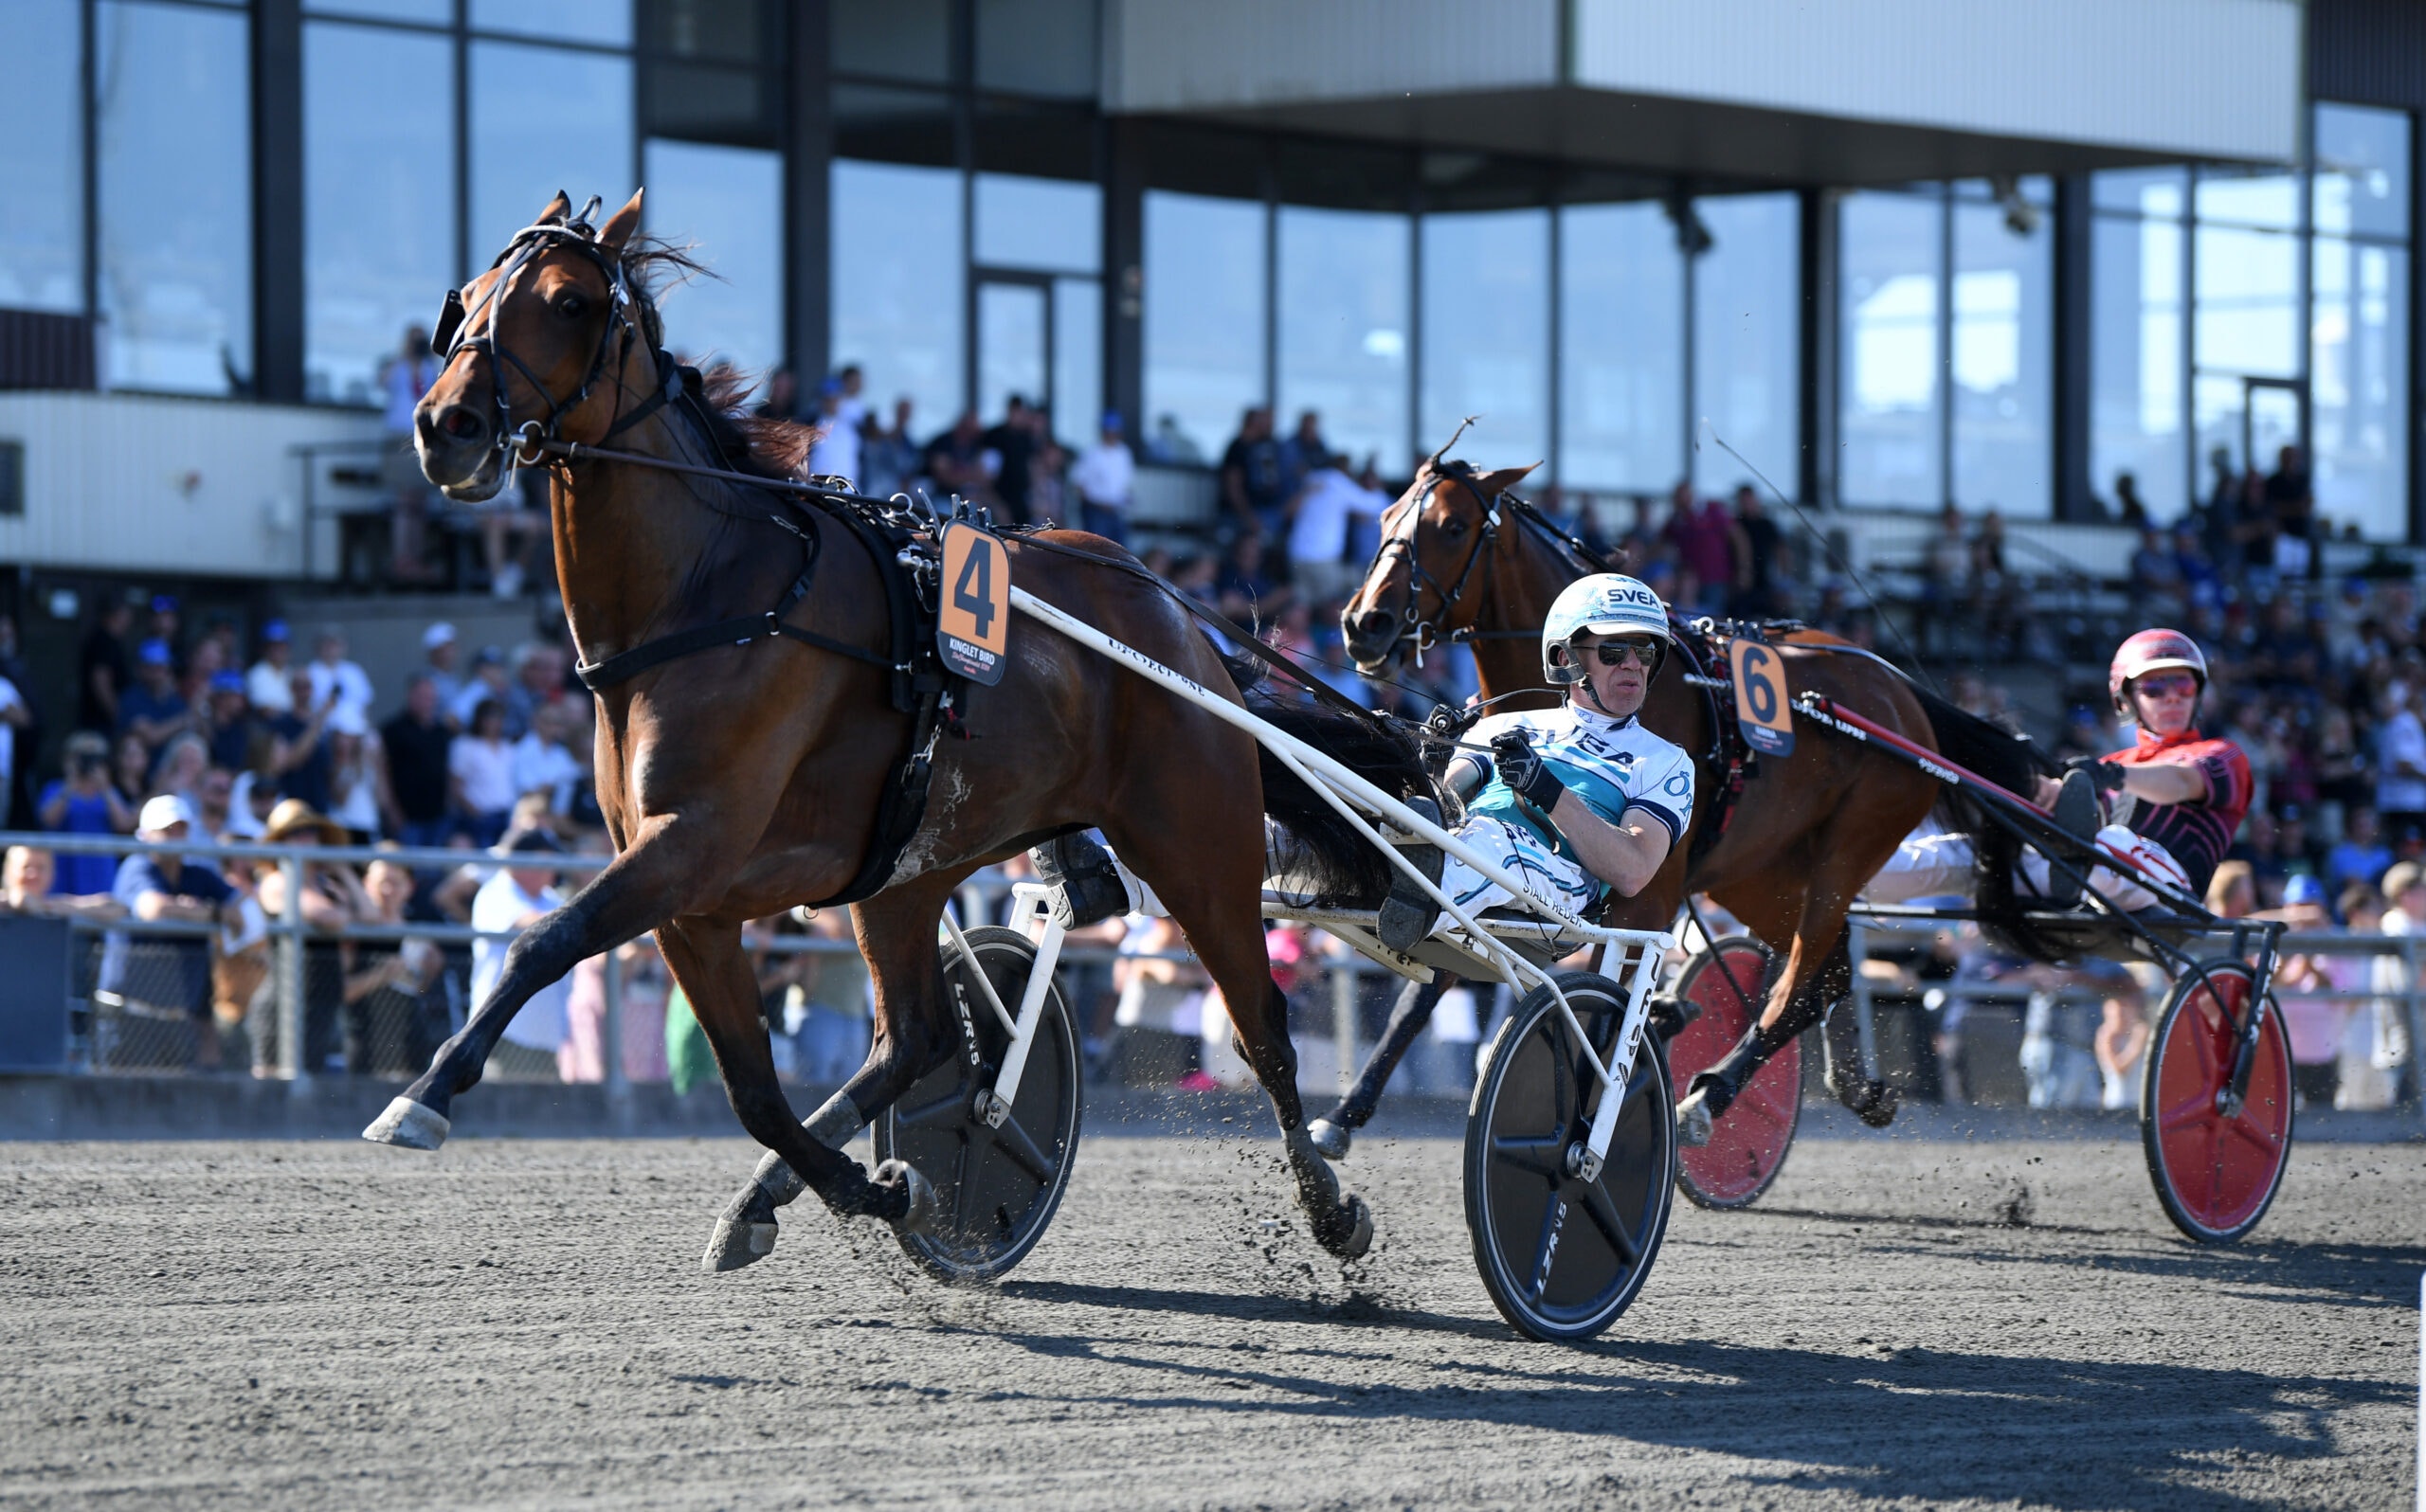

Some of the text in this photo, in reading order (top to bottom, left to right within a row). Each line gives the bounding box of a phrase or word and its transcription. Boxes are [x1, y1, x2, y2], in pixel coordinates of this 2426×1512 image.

[953, 536, 996, 639] 4
[1607, 588, 1659, 608] SVEA
[949, 638, 979, 658] KINGLET
[978, 649, 996, 666] BIRD
[1742, 646, 1778, 724] 6
[1523, 884, 1549, 907] STALL
